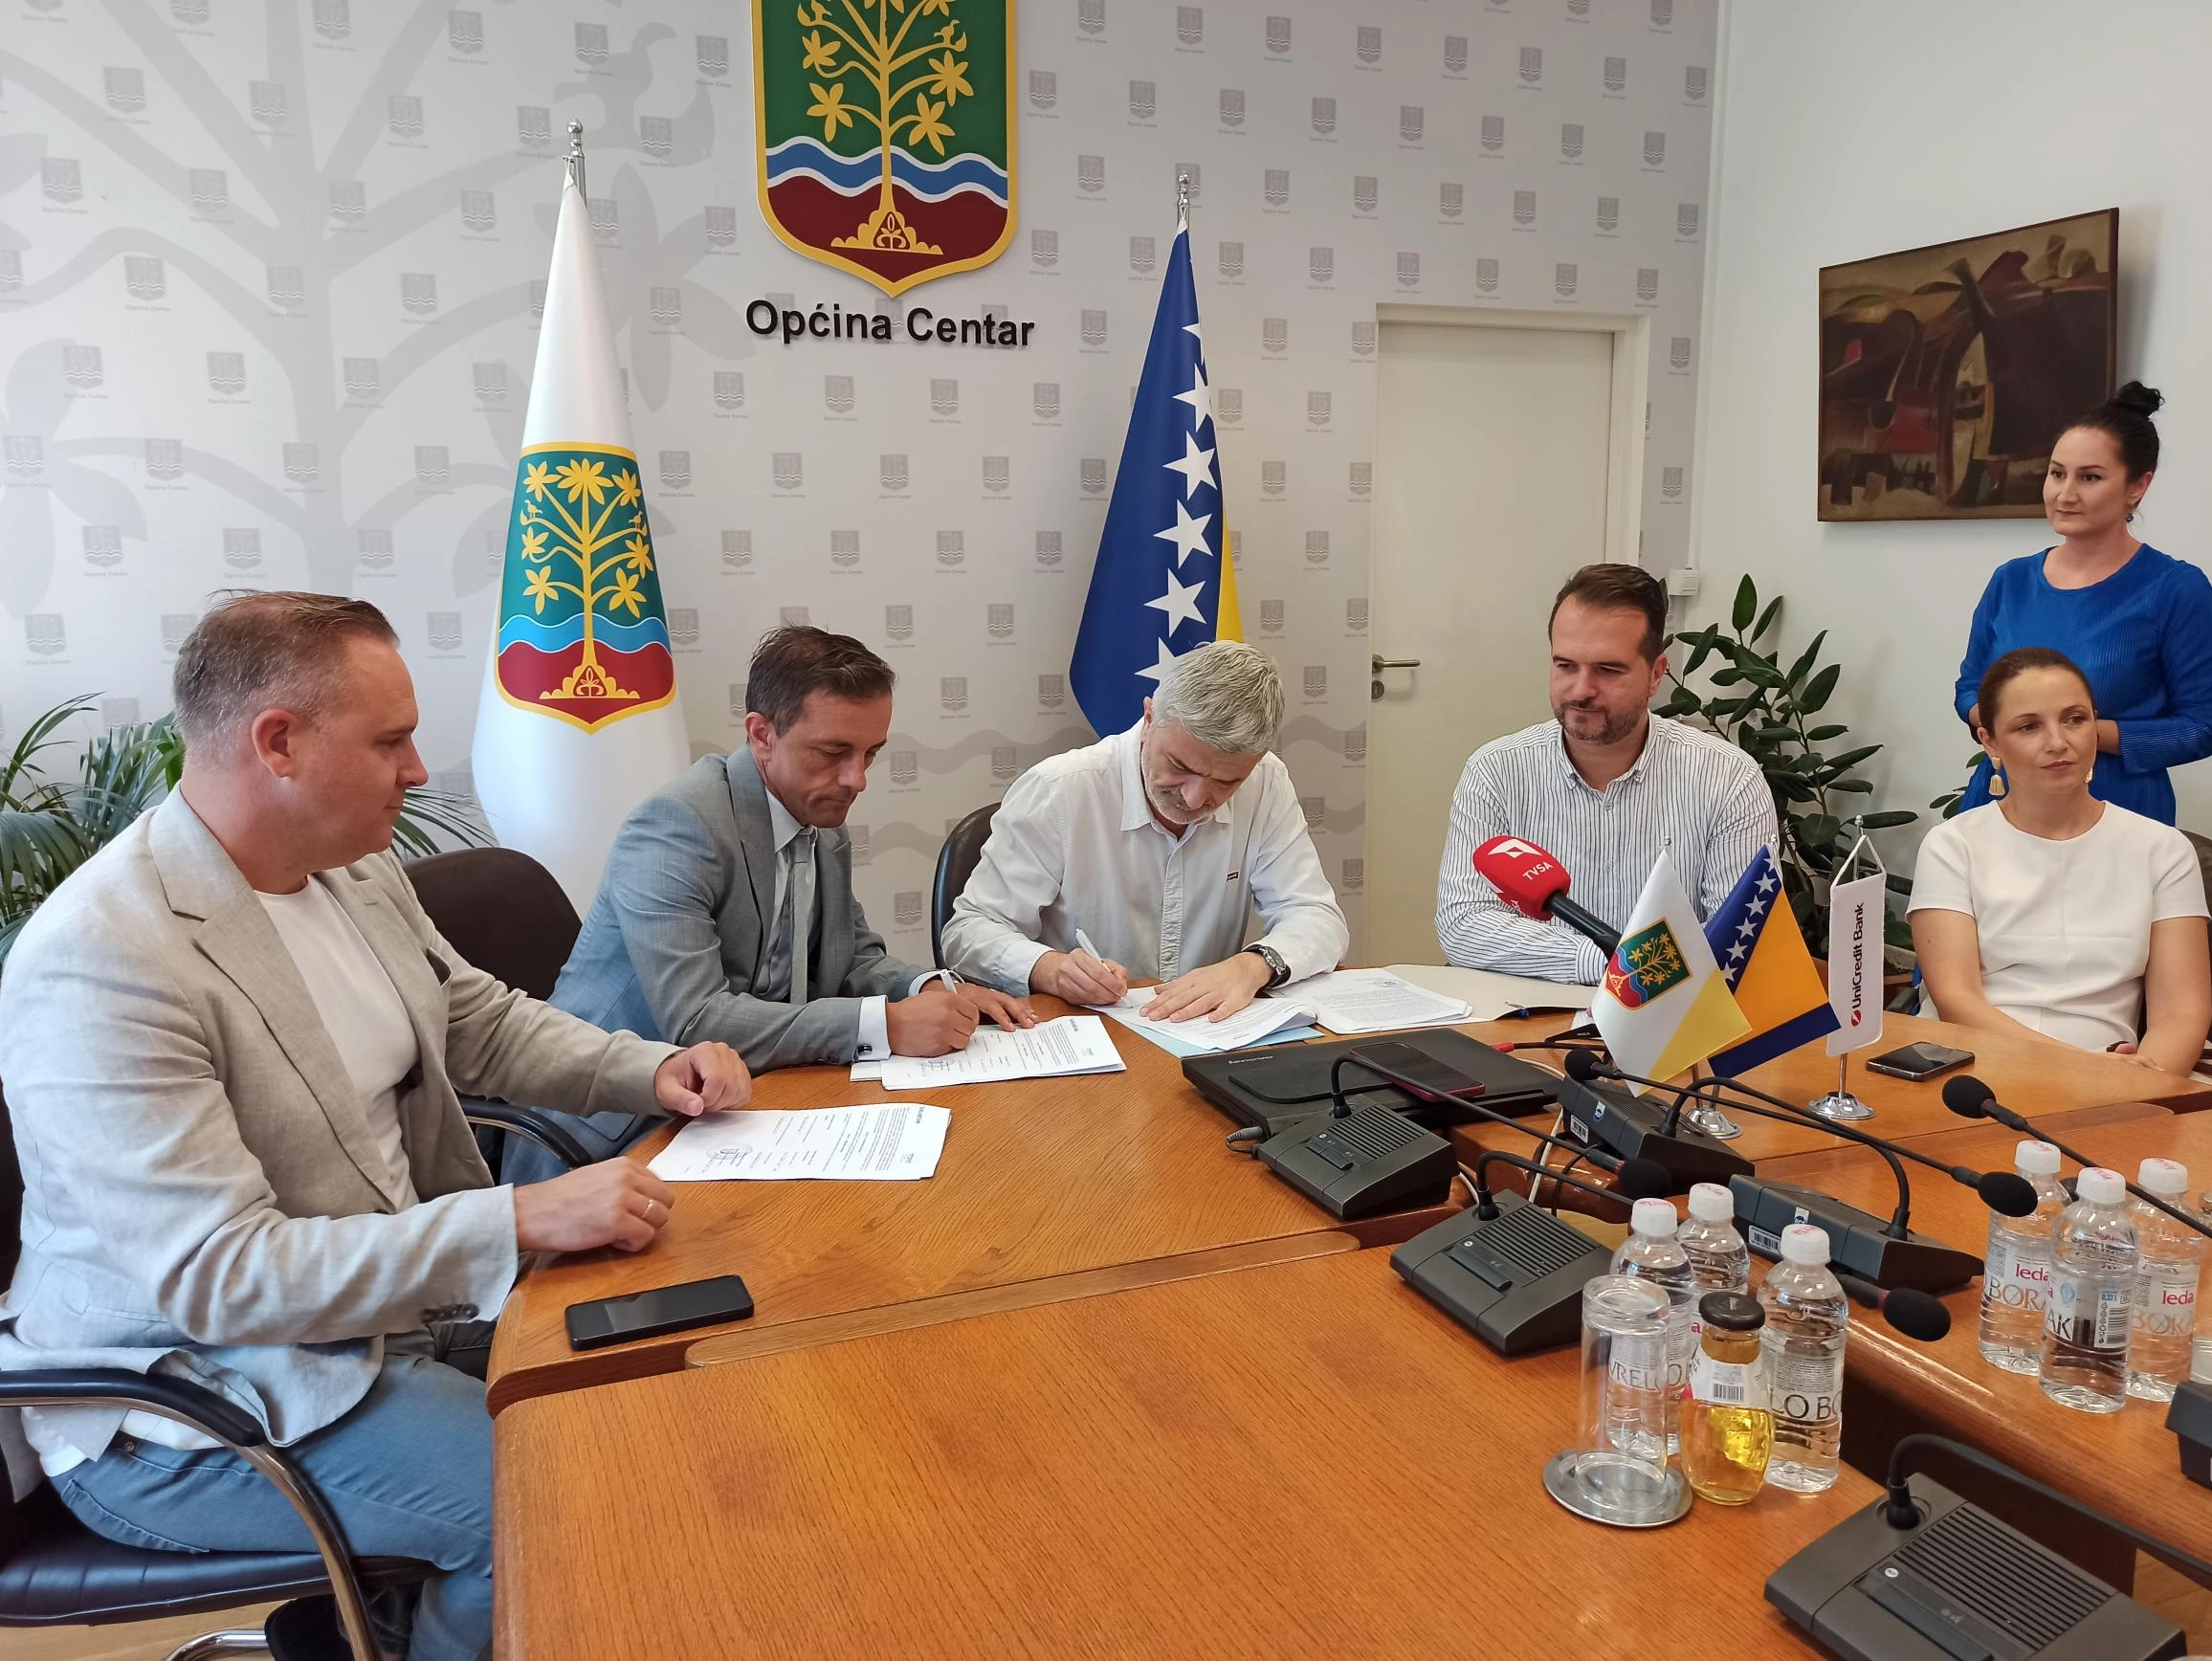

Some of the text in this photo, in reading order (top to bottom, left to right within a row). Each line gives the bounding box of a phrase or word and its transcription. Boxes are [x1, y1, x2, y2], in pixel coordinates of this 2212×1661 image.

[745, 299, 1035, 346] Općina Centar
[1522, 861, 1554, 880] TVSA
[1851, 901, 1864, 1009] UniCredit Bank
[2161, 1289, 2194, 1305] leda
